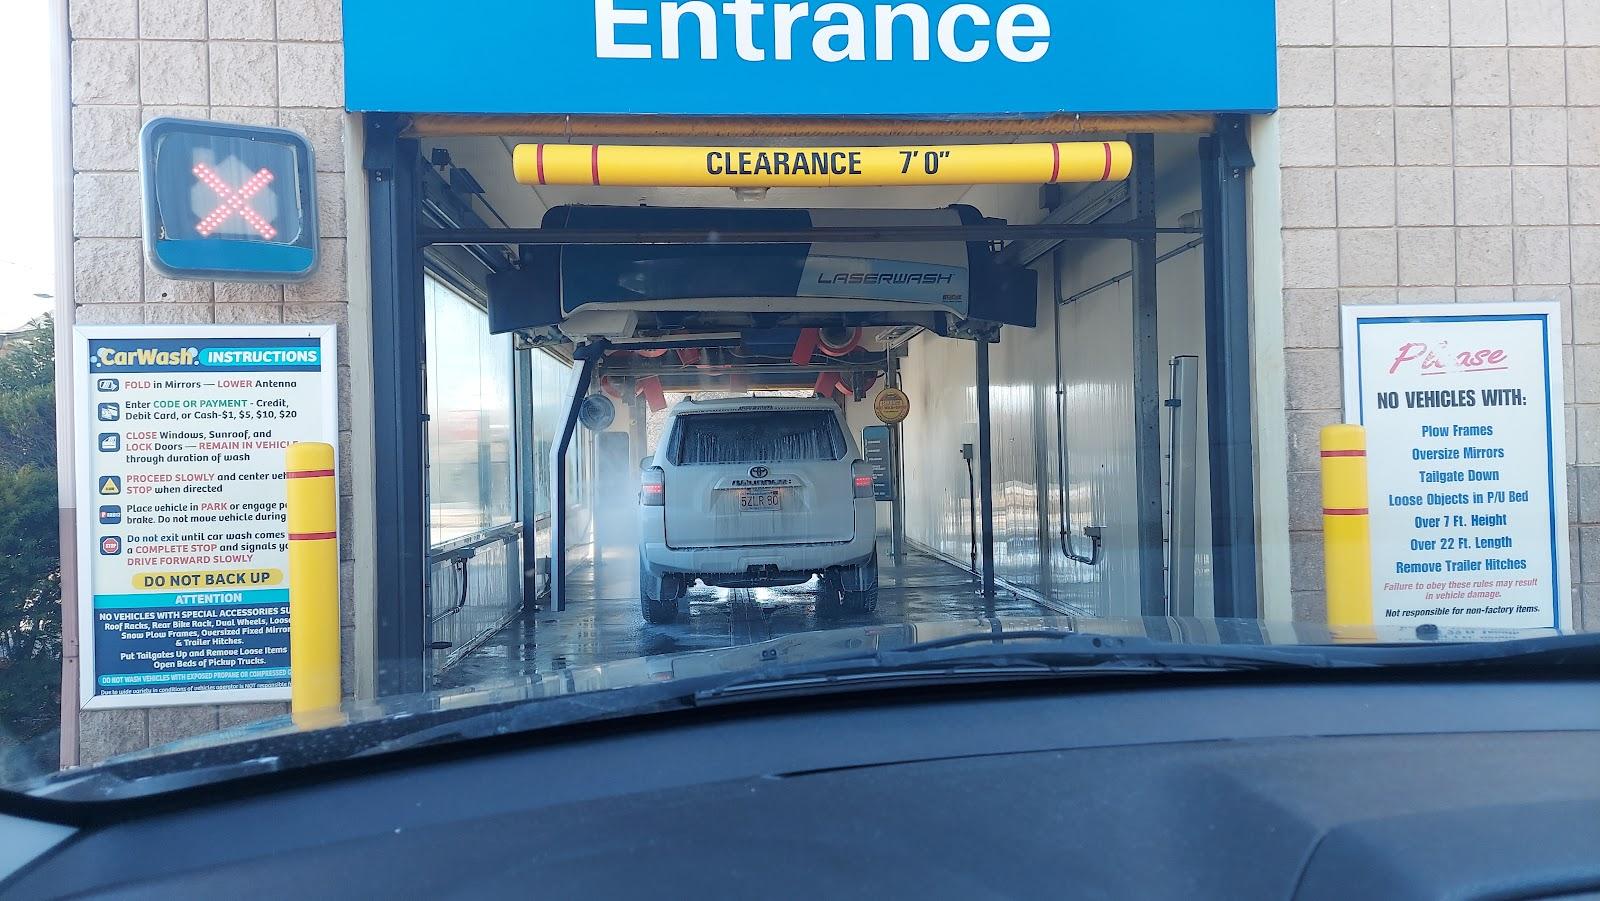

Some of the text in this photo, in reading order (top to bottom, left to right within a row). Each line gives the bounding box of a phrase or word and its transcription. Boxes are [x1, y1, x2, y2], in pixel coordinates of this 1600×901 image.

[594, 0, 1051, 62] Entrance
[706, 152, 862, 174] CLEARANCE
[900, 151, 919, 174] 7'
[818, 273, 953, 284] LASERWASH
[101, 348, 318, 366] CarWash INSTRUCTIONS
[125, 380, 297, 389] FOLD in Mirrors LOWER Antenna
[125, 398, 289, 409] Enter CODE OR PAYMENT Credit,
[1377, 389, 1527, 409] NO VEHICLES WITH:
[125, 411, 151, 420] Debit
[154, 411, 179, 421] Card,
[256, 410, 277, 419] $10,
[279, 410, 297, 419] $20
[126, 429, 272, 441] CLOSE Windows, Sunroof, and
[1422, 425, 1493, 437] Plow Frames
[126, 440, 298, 452] LOCK Doors REMAIN IN VEHIC
[126, 453, 250, 465] through duration of wash
[1412, 447, 1504, 460] Oversize Mirrors
[127, 474, 173, 483] PROCEED
[175, 474, 215, 482] SLOWLY
[217, 472, 236, 482] and
[238, 473, 269, 481] center
[1419, 470, 1499, 483] Tailgate Down
[127, 484, 223, 494] STOP when directed
[1389, 491, 1528, 506] Loose Objects in P/U Bed
[127, 504, 152, 512] Place
[154, 503, 188, 512] vehicle
[190, 503, 199, 511] in
[201, 503, 228, 511] PARK
[242, 503, 276, 512] engage
[127, 515, 155, 524] brake.
[158, 515, 170, 524] Do
[172, 515, 188, 523] not
[190, 515, 216, 523] move
[218, 513, 253, 522] vehicle
[255, 512, 286, 522] during
[1415, 514, 1507, 528] Over 7 Ft. Height
[127, 535, 140, 543] Do
[161, 534, 179, 542] exit
[181, 533, 205, 541] until
[226, 532, 252, 540] wash
[1411, 536, 1512, 550] Over 22 Ft. Length
[135, 545, 188, 554] COMPLETE
[190, 544, 217, 552] STOP
[220, 543, 238, 552] and
[241, 541, 277, 554] signals
[127, 554, 253, 566] DRIVE FORWARD SLOWLY
[1396, 559, 1526, 573] Remove Trailer Hitches
[144, 572, 270, 588] DO NOT BACK UP
[1427, 582, 1446, 590] obey
[1449, 580, 1470, 589] these
[1473, 580, 1493, 588] rules
[1496, 580, 1512, 588] may
[1516, 578, 1538, 586] result
[175, 593, 242, 605] ATTENTION
[1426, 592, 1433, 600] in
[1436, 591, 1465, 599] vehicle
[99, 612, 112, 621] NO
[114, 612, 155, 620] VEHICLES
[157, 611, 180, 619] WITH
[182, 610, 218, 618] SPECIAL
[219, 608, 278, 617] ACCESSORIES
[1385, 608, 1400, 617] Not
[1402, 606, 1449, 617] responsible
[1452, 606, 1464, 615] for
[1466, 605, 1514, 615] non-factory
[105, 622, 123, 632] Roof
[152, 621, 171, 629] Rear
[173, 620, 191, 628] Bike
[216, 618, 234, 627] Dual
[121, 632, 144, 640] Snow
[145, 630, 166, 638] Plow
[201, 628, 241, 637] Oversized
[242, 627, 264, 636] Fixed
[266, 626, 290, 634] Mirror
[184, 638, 211, 646] Trailer
[120, 646, 288, 661] Put Tailgates Up and Remove Loose Items
[154, 661, 175, 670] Open
[177, 660, 196, 668] Beds
[198, 659, 207, 669] of
[209, 658, 236, 667] Pickup
